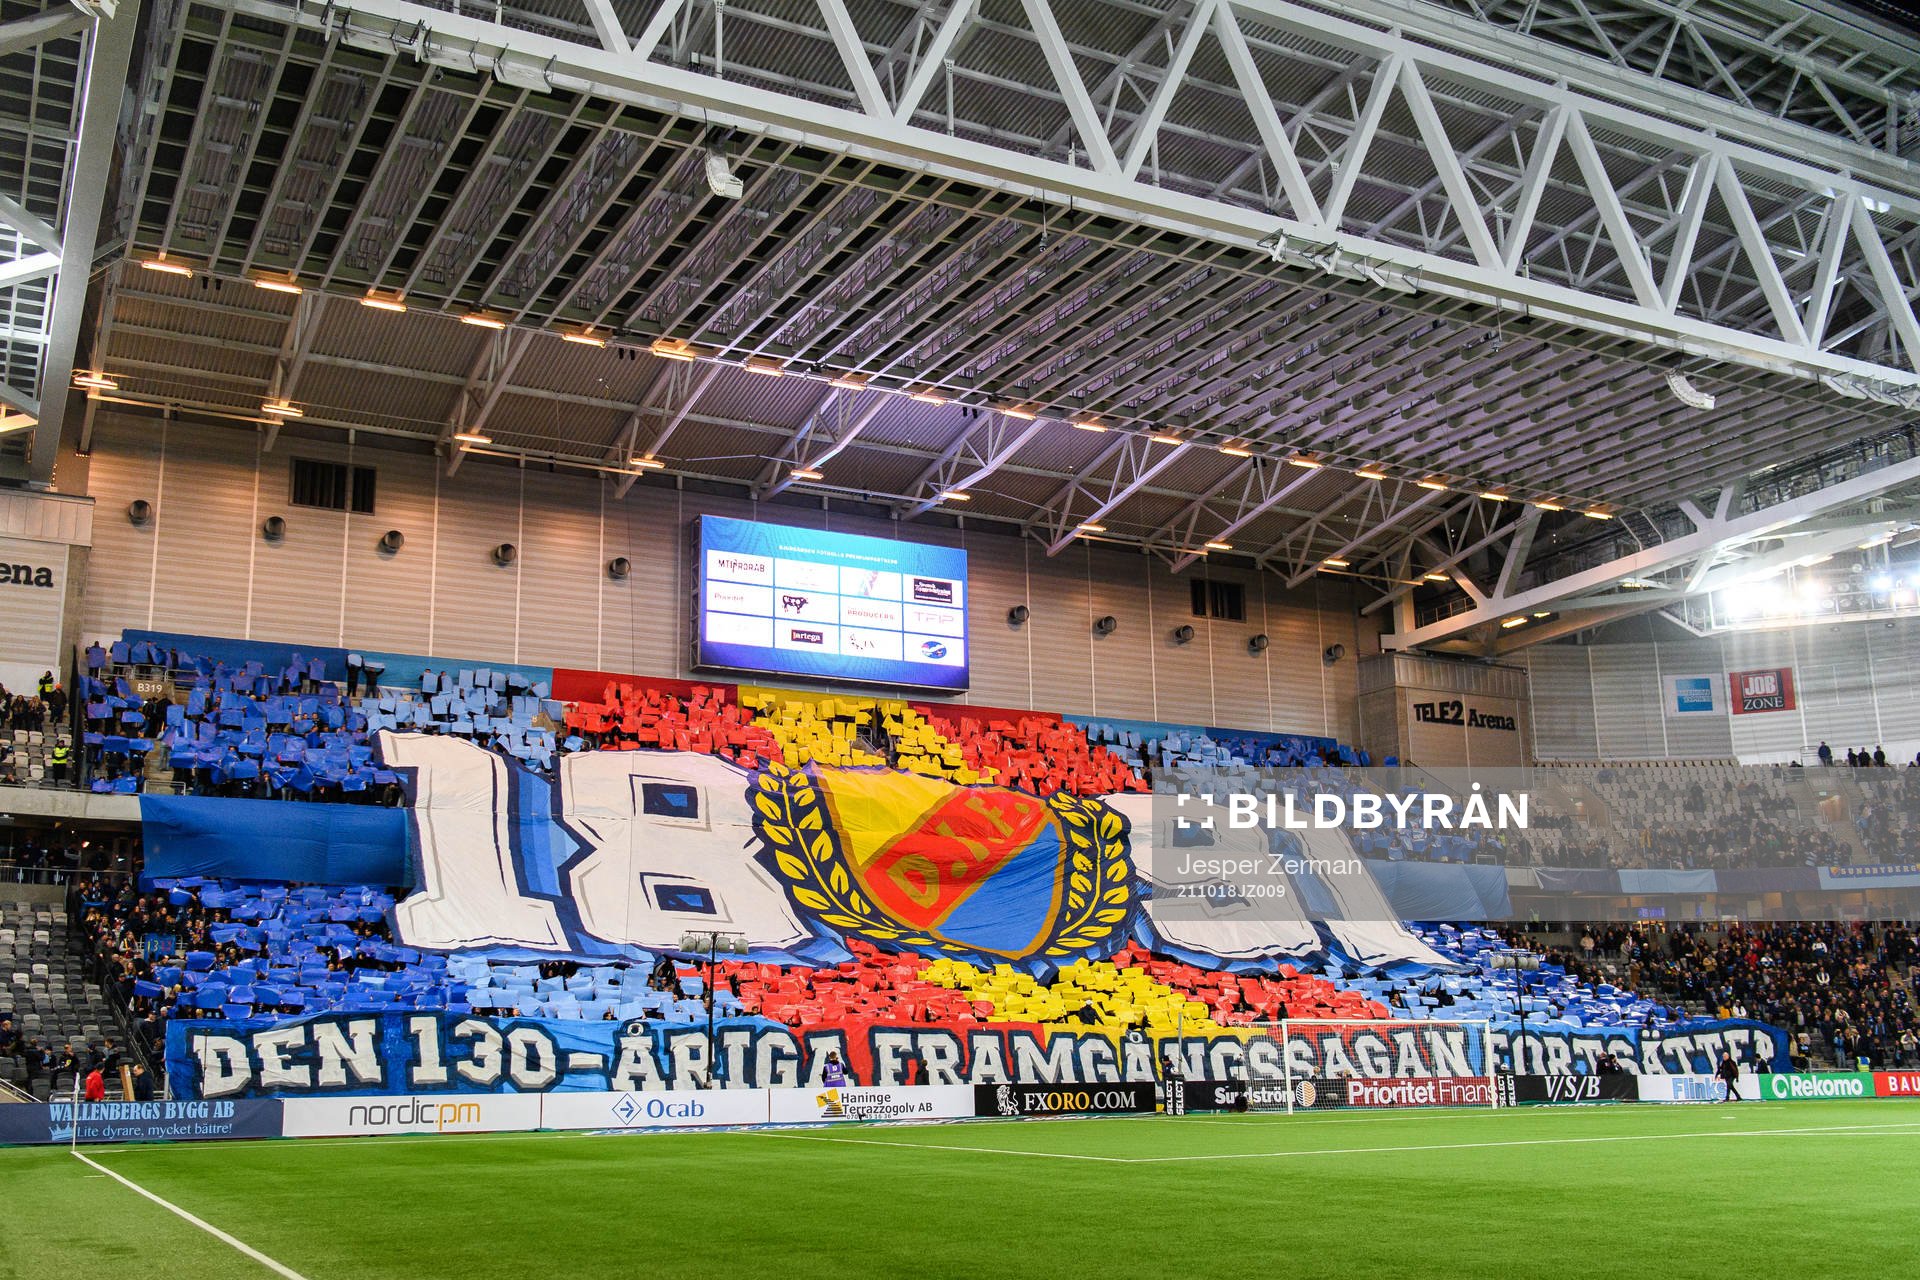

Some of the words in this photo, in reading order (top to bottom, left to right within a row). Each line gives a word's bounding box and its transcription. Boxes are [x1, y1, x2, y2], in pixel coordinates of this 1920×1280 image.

[137, 683, 162, 693] B319
[1745, 675, 1776, 696] JOB
[1744, 696, 1784, 710] ZONE
[1413, 700, 1464, 726] TELE2
[1467, 708, 1516, 731] Arena
[193, 1019, 382, 1098] DEN
[1348, 1080, 1436, 1104] Prioritet
[1498, 1075, 1506, 1107] SELECT
[1507, 1074, 1516, 1106] SELECT
[1545, 1076, 1600, 1101] V/S/B
[1790, 1075, 1863, 1096] Rekomo
[646, 1099, 705, 1118] Ocab
[841, 1092, 891, 1104] Haninge
[842, 1102, 915, 1115] Terrazzogolv
[918, 1102, 933, 1112] AB
[1024, 1091, 1136, 1111] FXORO.COM
[1176, 1081, 1184, 1116] SELECT
[49, 1102, 161, 1122] WALLENBERGS
[165, 1101, 208, 1119] BYGG
[213, 1101, 235, 1118] AB
[77, 1125, 98, 1137] Lite
[102, 1124, 144, 1139] dyrare,
[148, 1123, 191, 1138] mycket
[195, 1122, 232, 1135] bättre!
